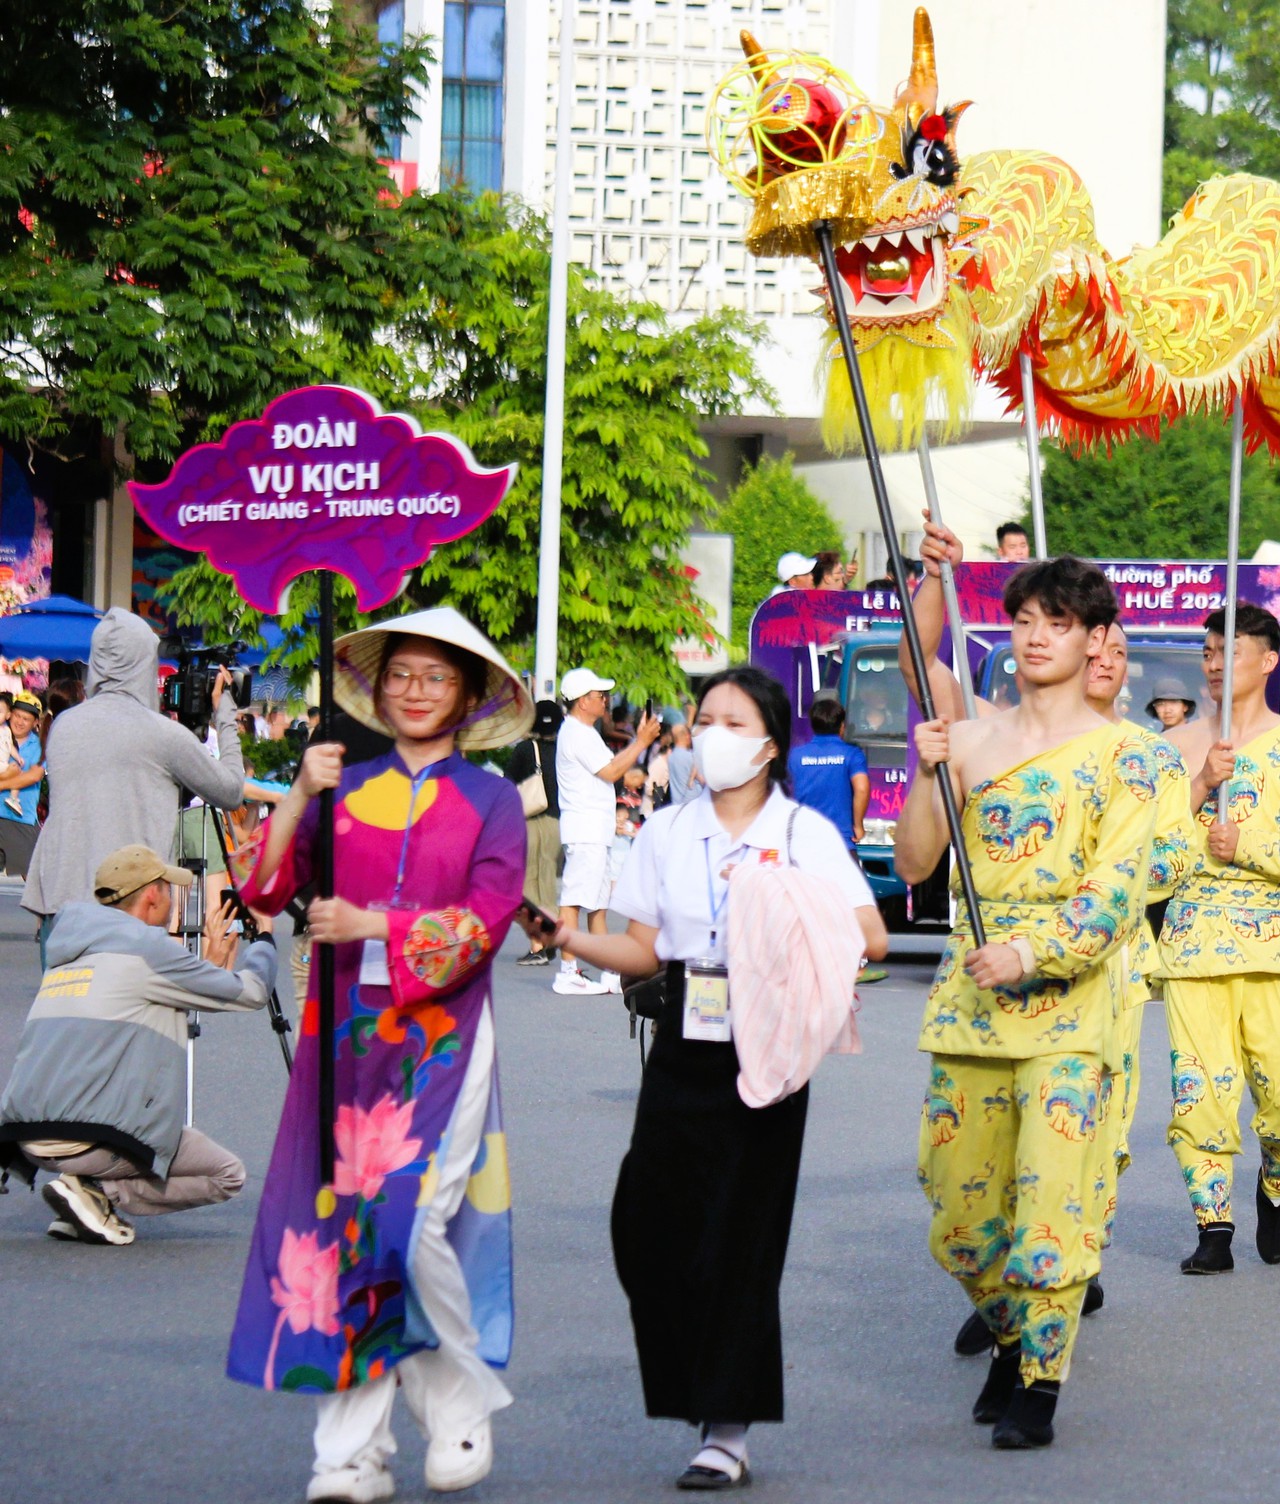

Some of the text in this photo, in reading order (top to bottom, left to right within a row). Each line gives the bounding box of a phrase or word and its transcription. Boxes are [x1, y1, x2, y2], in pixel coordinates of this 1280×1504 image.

[271, 416, 357, 450] ĐOÀN
[248, 461, 380, 500] VỤ KỊCH
[177, 499, 243, 527] (CHIẾT
[245, 500, 309, 521] GIANG
[325, 499, 394, 518] TRUNG
[397, 492, 461, 518] QUỐC)
[1171, 565, 1215, 586] phố
[1125, 588, 1176, 609] HUẾ
